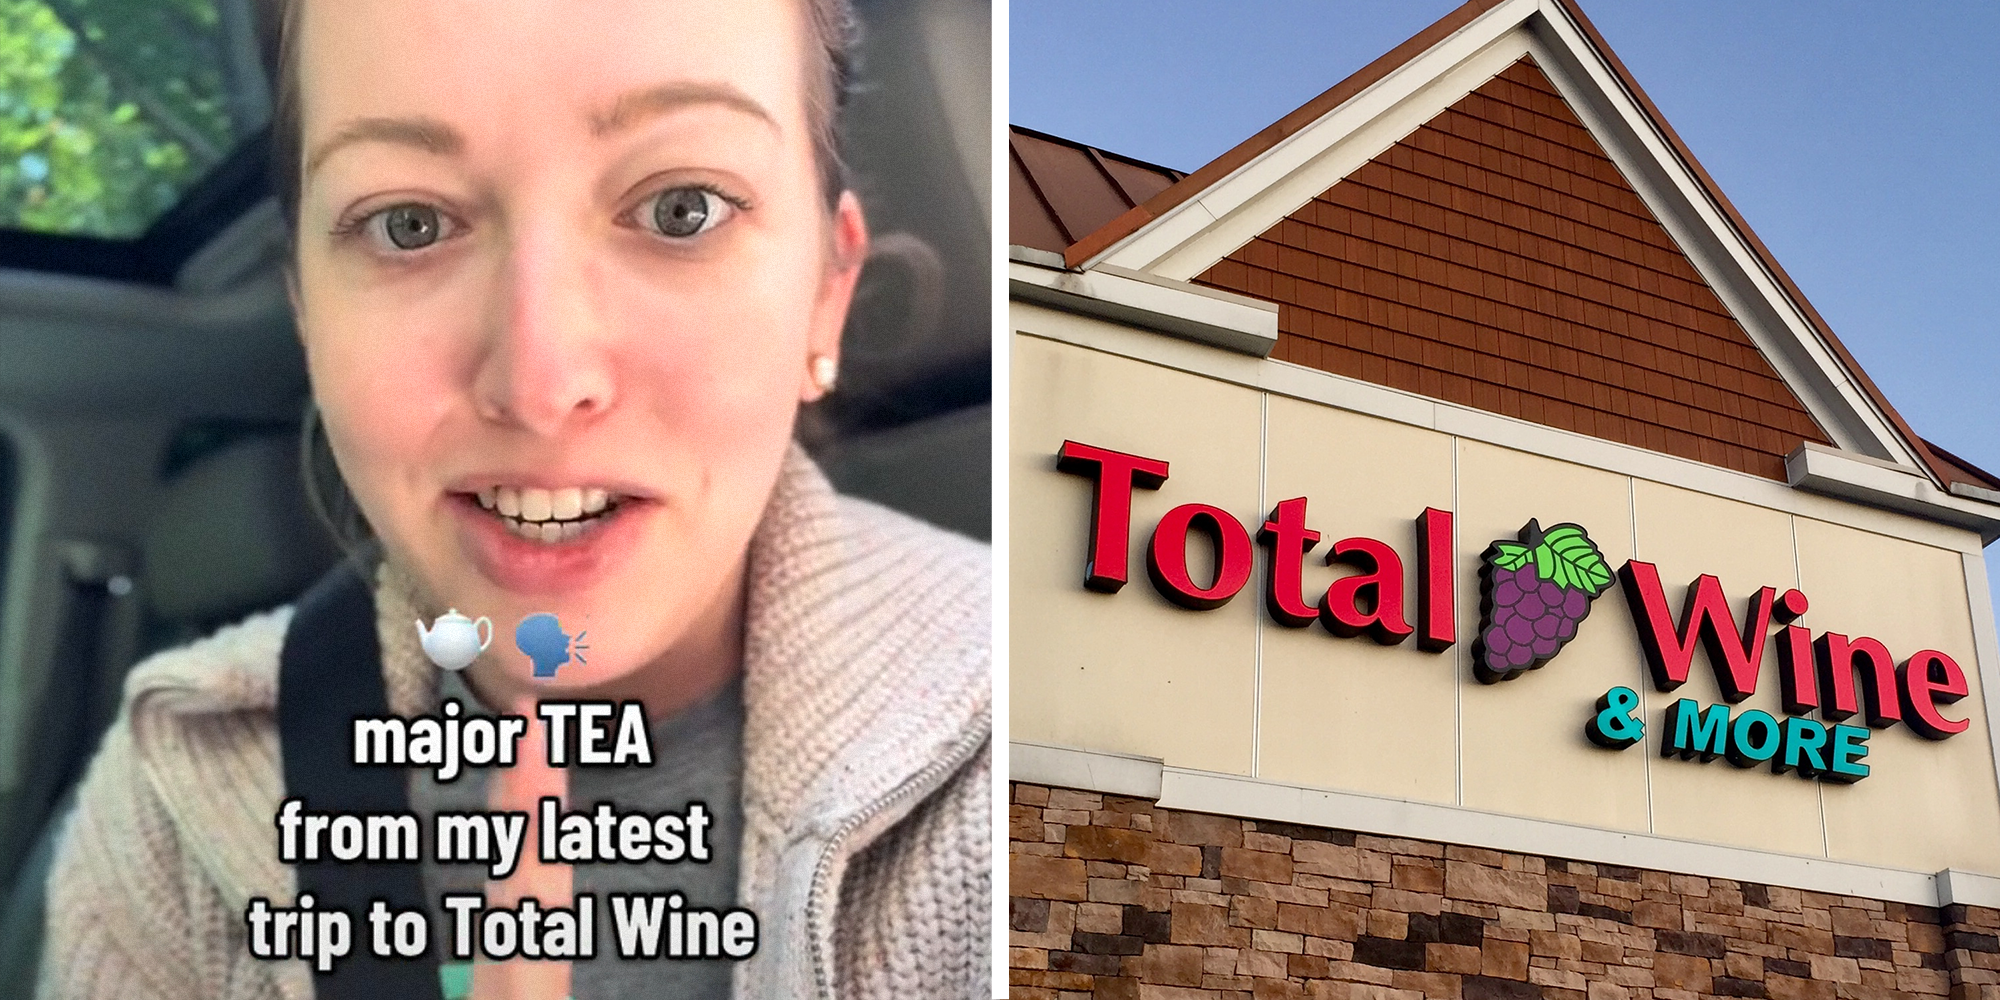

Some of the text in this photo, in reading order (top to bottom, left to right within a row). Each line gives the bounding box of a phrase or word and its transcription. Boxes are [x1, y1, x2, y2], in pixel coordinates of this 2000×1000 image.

[1058, 440, 1970, 738] Total Wine
[1588, 686, 1871, 782] & MORE
